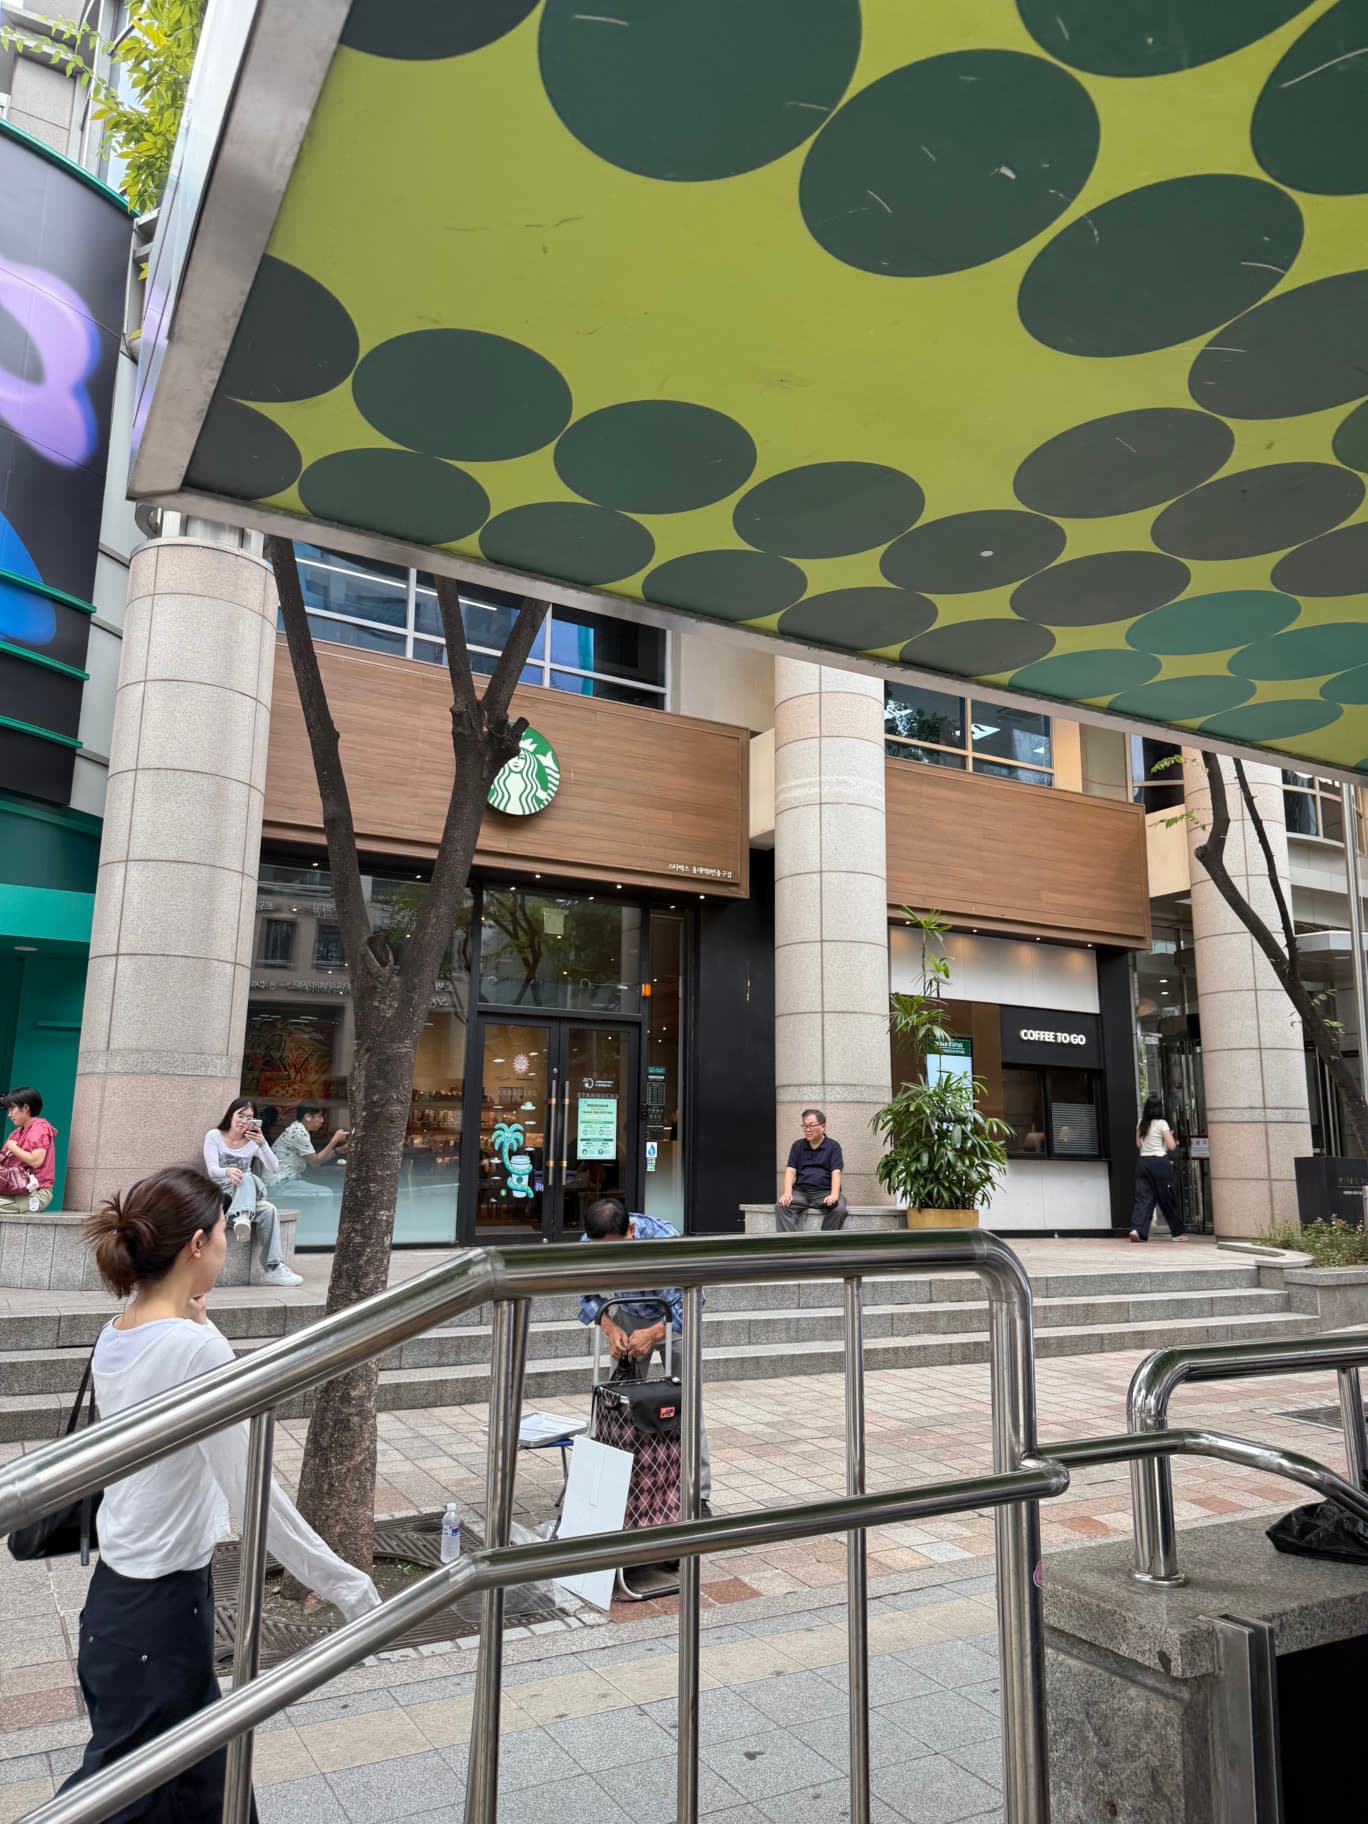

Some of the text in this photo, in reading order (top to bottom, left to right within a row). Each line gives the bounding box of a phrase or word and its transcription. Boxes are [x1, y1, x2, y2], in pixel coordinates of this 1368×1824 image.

[667, 863, 689, 872] 스타벅스
[1020, 1029, 1086, 1045] COFFEE TO GO
